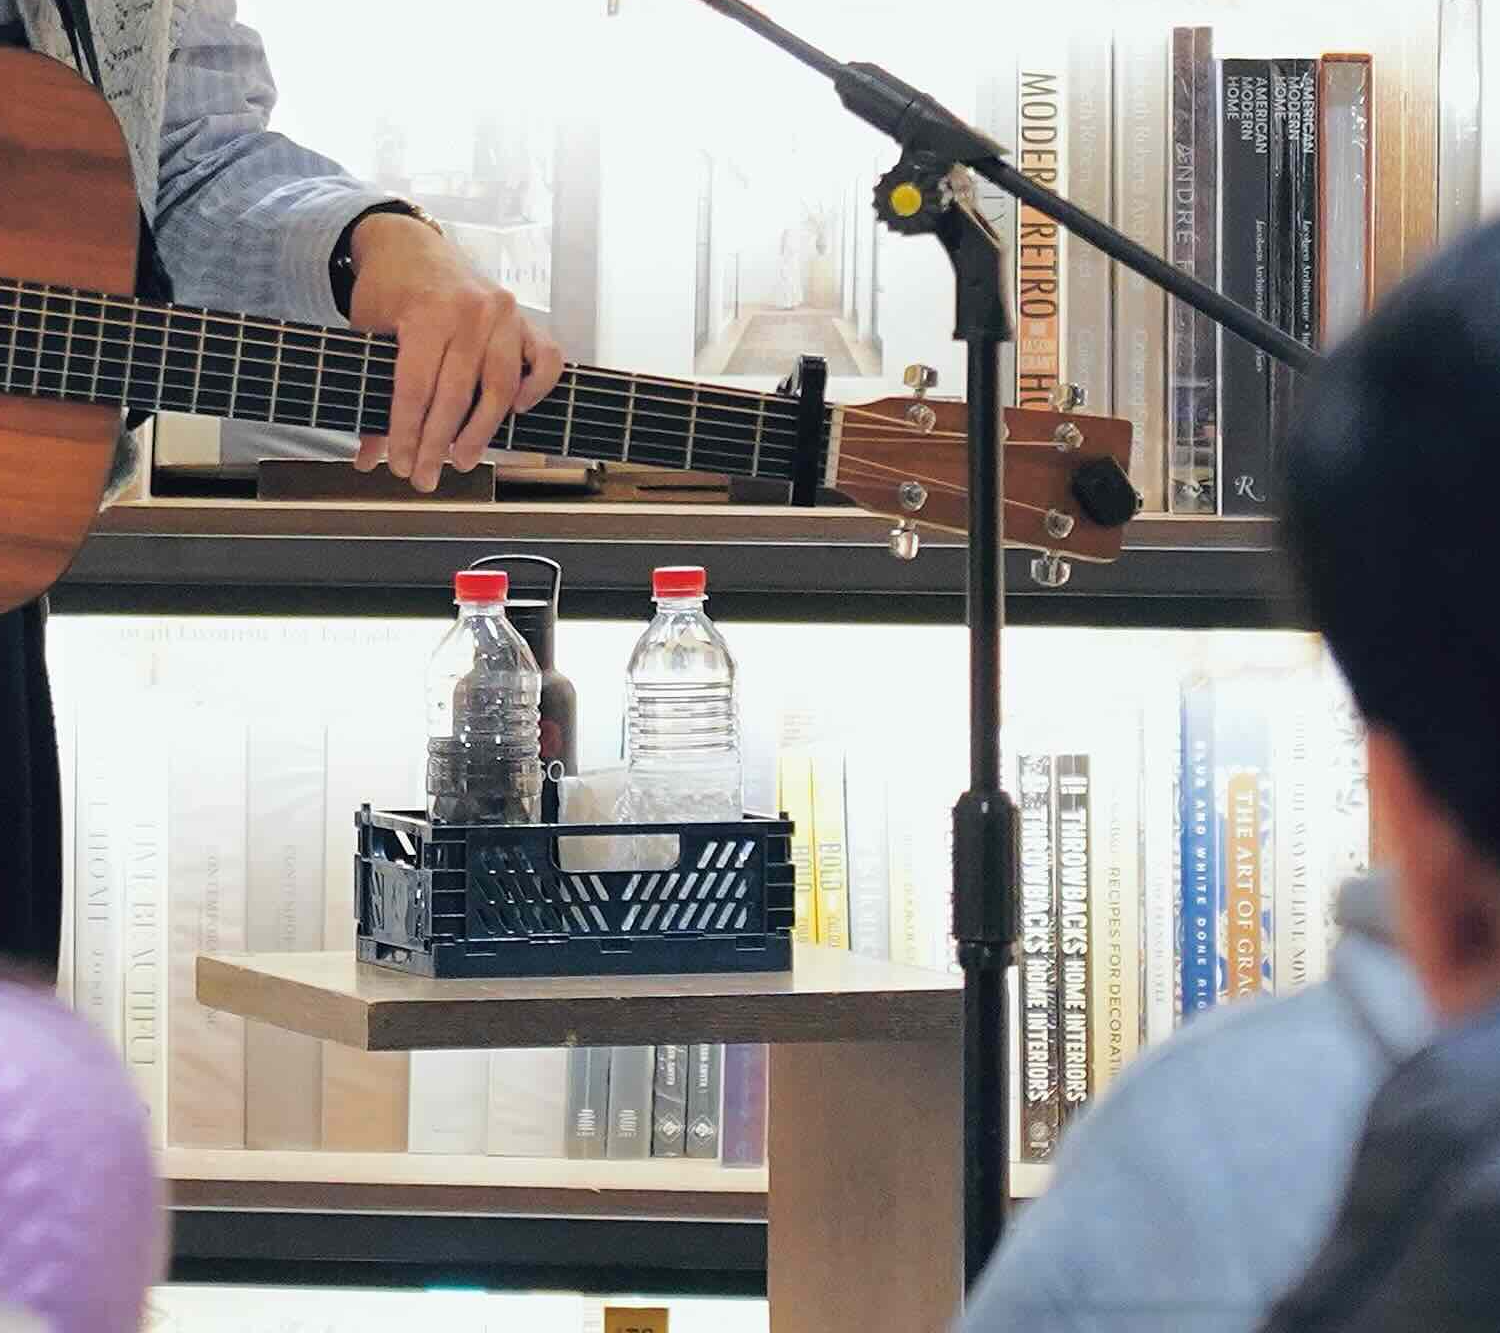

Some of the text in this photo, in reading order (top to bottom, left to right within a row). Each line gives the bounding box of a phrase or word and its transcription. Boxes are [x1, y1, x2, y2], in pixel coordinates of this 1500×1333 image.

[1225, 75, 1238, 119] HOME
[1239, 75, 1252, 141] MODERN
[1255, 75, 1267, 155] AMERICAN
[1022, 222, 1056, 319] RETRO
[1235, 791, 1254, 934] THE ART OF
[1060, 809, 1088, 1104] THROWBACKS HOME INTERIORS
